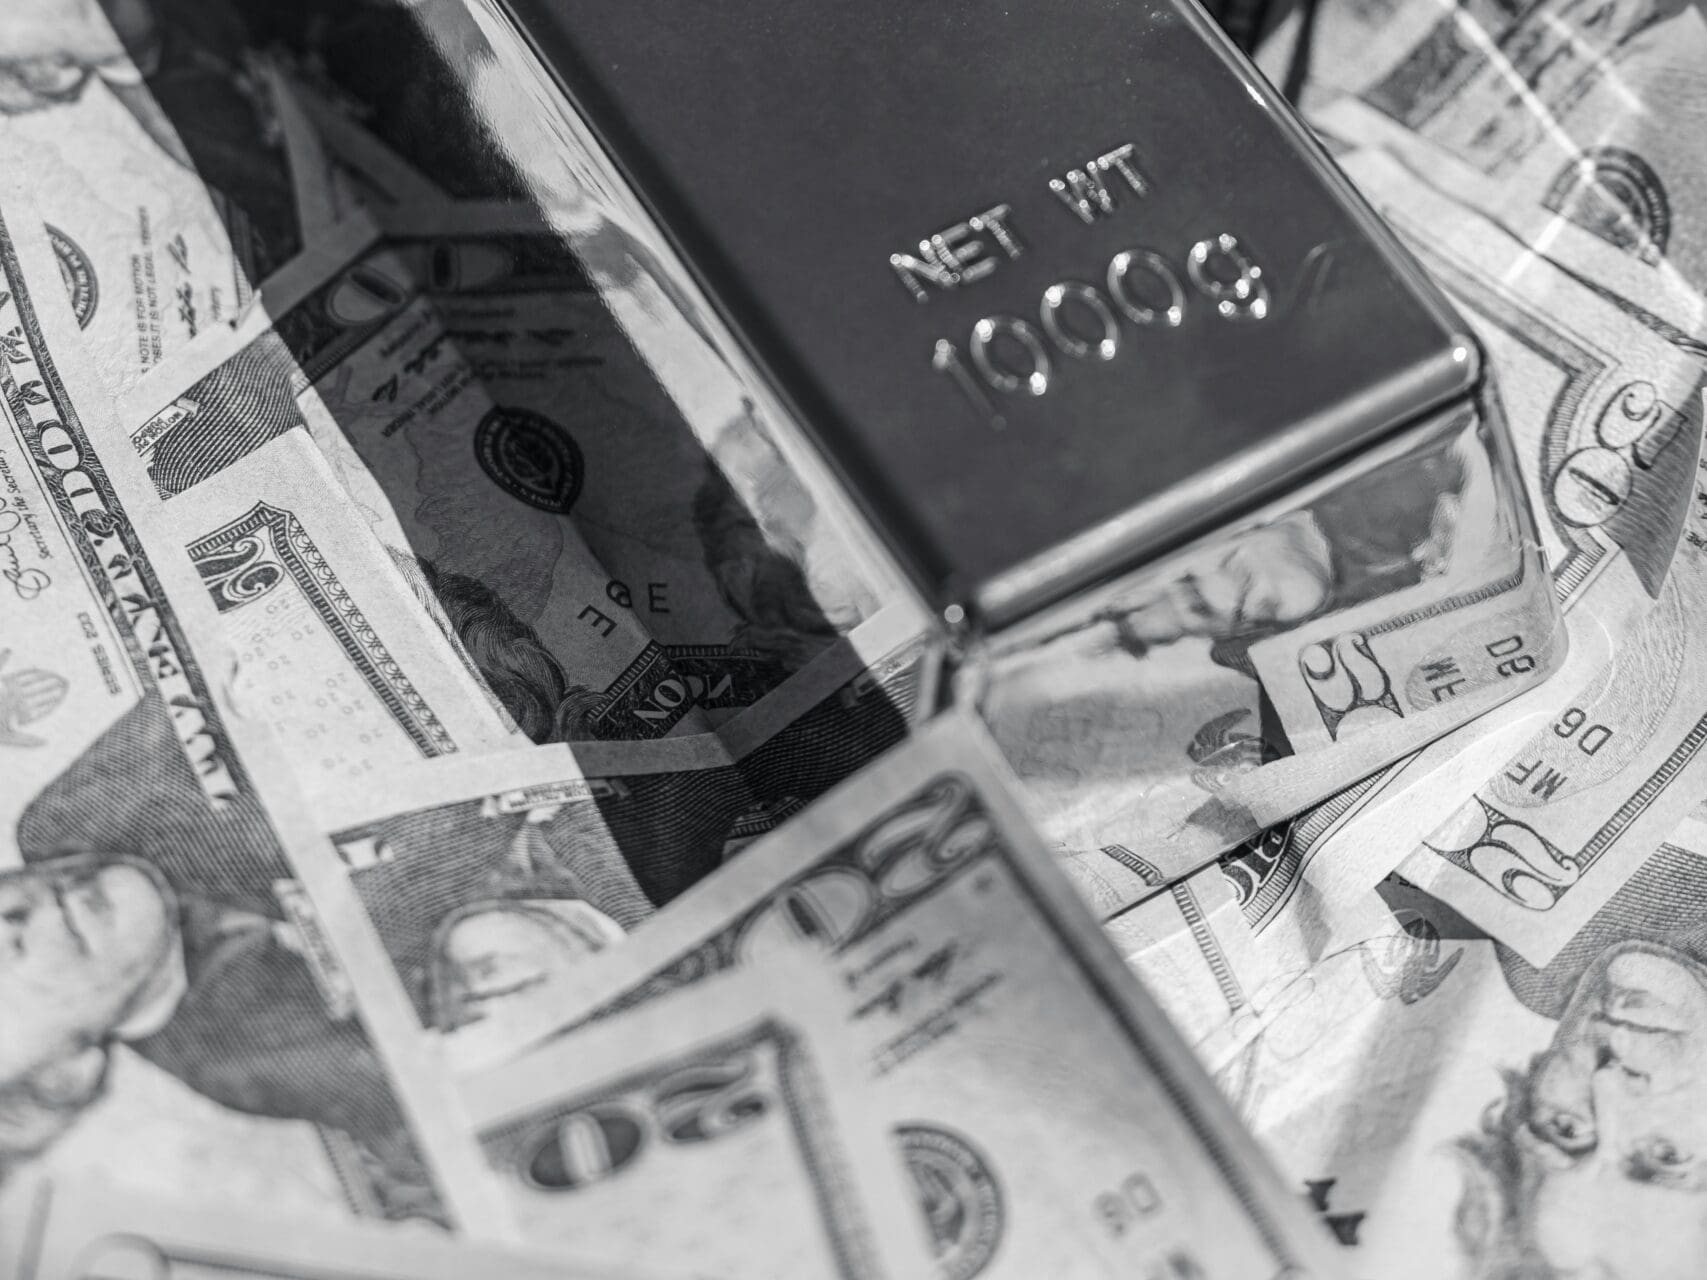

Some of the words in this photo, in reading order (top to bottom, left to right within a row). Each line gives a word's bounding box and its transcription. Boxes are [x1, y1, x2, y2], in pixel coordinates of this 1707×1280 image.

[890, 203, 1022, 304] NET
[1049, 143, 1152, 223] WT
[131, 254, 145, 295] MOTION
[138, 335, 149, 365] NOTE
[932, 232, 1270, 431] 1000g
[1552, 380, 1688, 529] 20
[90, 528, 238, 812] TWENTY
[1504, 759, 1569, 801] MF
[1553, 706, 1614, 757] D6
